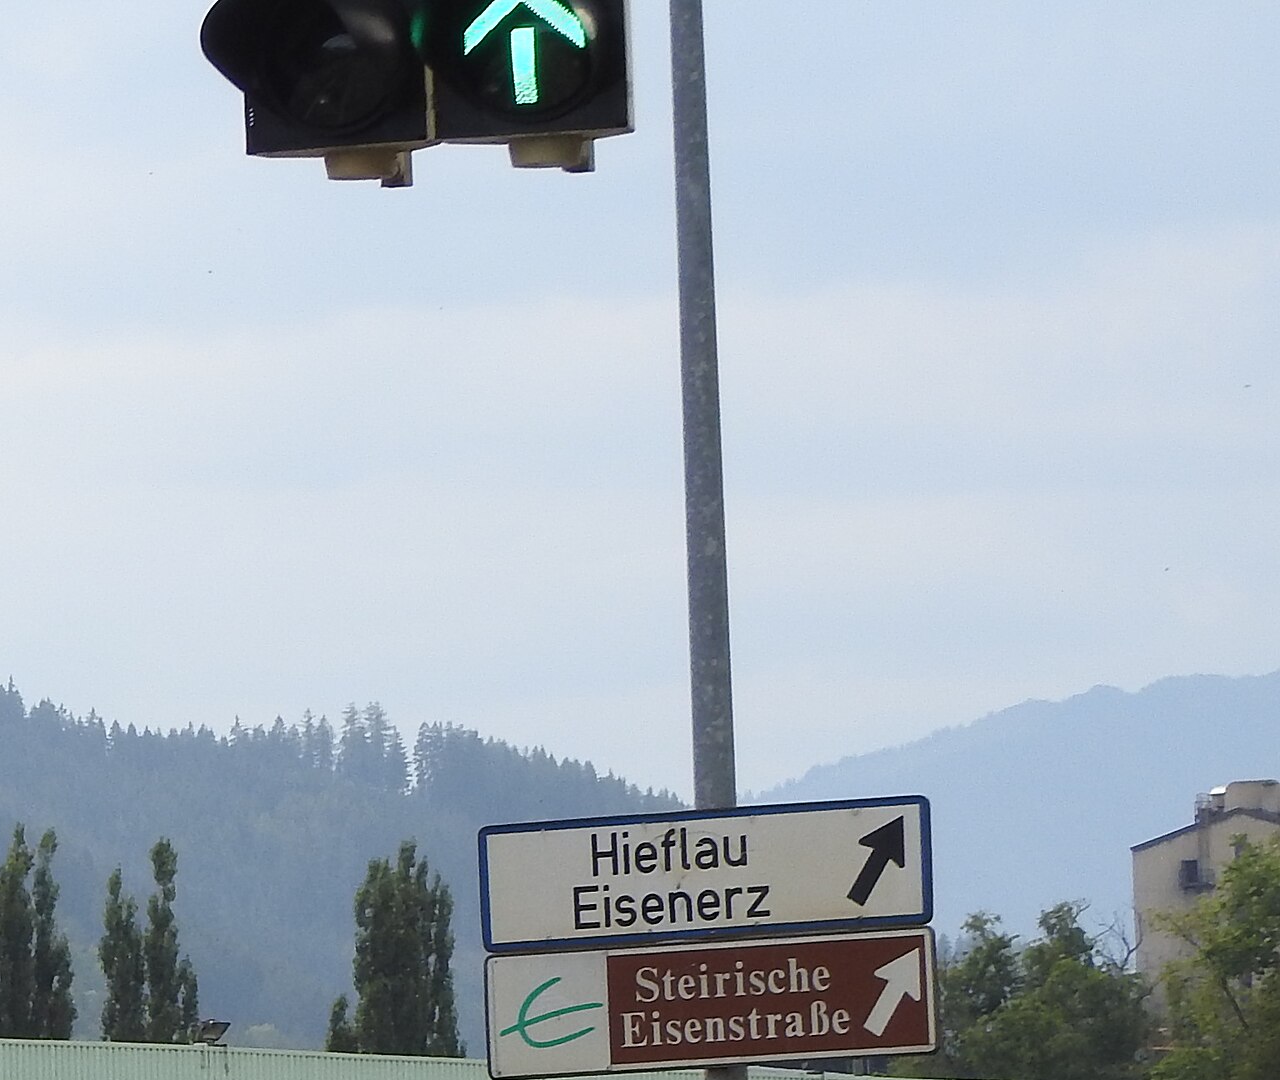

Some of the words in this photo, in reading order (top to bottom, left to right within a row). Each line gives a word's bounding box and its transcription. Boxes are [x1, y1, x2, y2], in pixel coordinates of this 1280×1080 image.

[591, 827, 749, 876] Hieflau
[572, 884, 771, 930] Eisenerz
[635, 957, 831, 1003] Steirische
[621, 1001, 851, 1048] Eisenstraße
